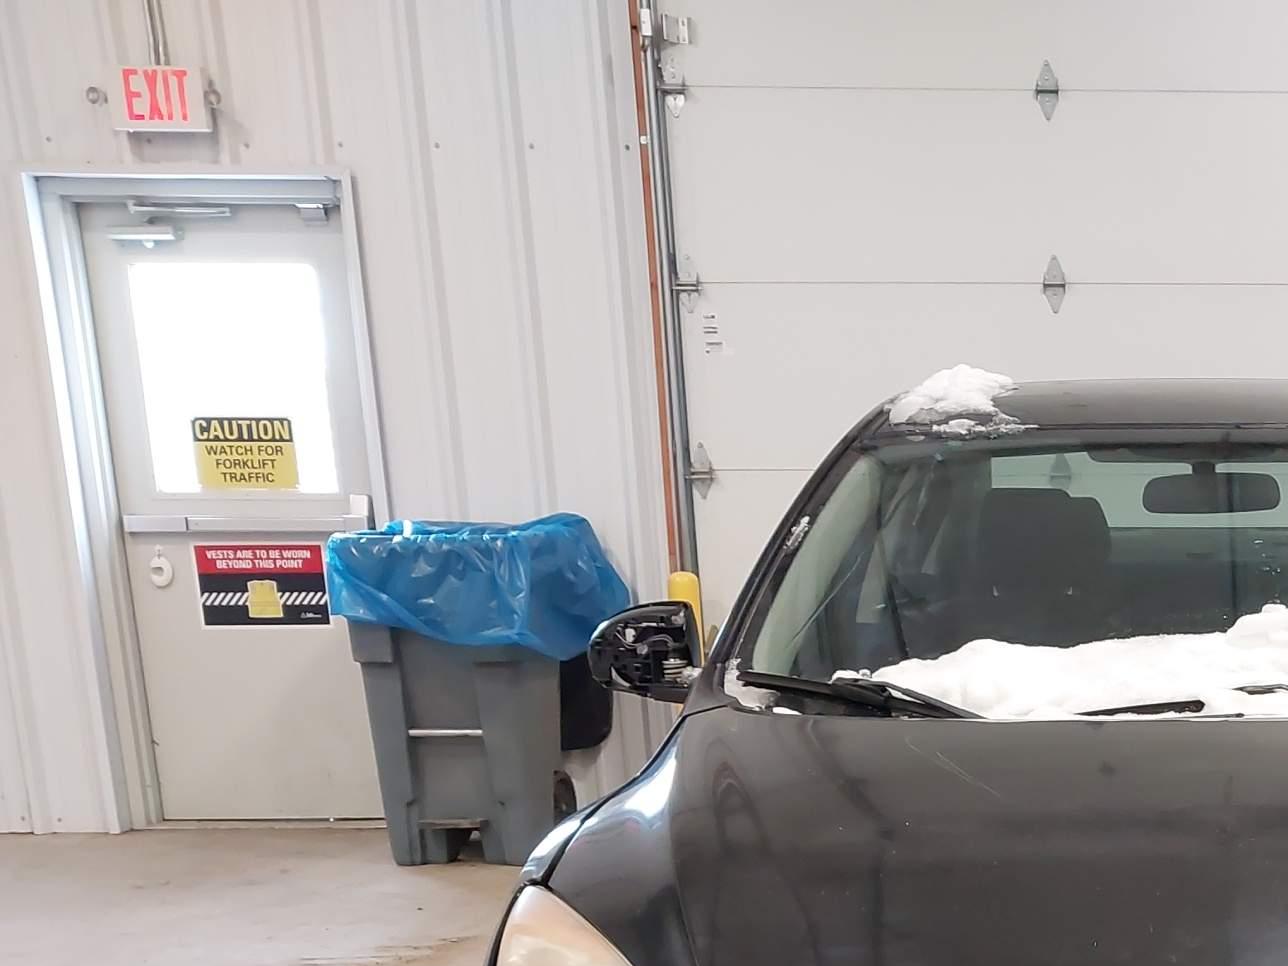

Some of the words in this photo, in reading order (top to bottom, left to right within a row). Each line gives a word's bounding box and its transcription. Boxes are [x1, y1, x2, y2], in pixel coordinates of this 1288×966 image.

[121, 67, 189, 122] EXIT
[194, 419, 291, 440] CAUTION
[205, 445, 253, 456] WATCH
[257, 445, 284, 456] FOR
[215, 458, 277, 470] FORKLIFT
[220, 472, 275, 483] TRAFFIC
[205, 549, 234, 559] VESTS
[236, 549, 254, 559] ARE
[255, 549, 267, 559] TO
[269, 549, 279, 559] BE
[280, 549, 311, 559] WORN
[216, 559, 252, 569] BEYOND
[254, 559, 274, 569] THIS
[276, 559, 303, 569] POINT
